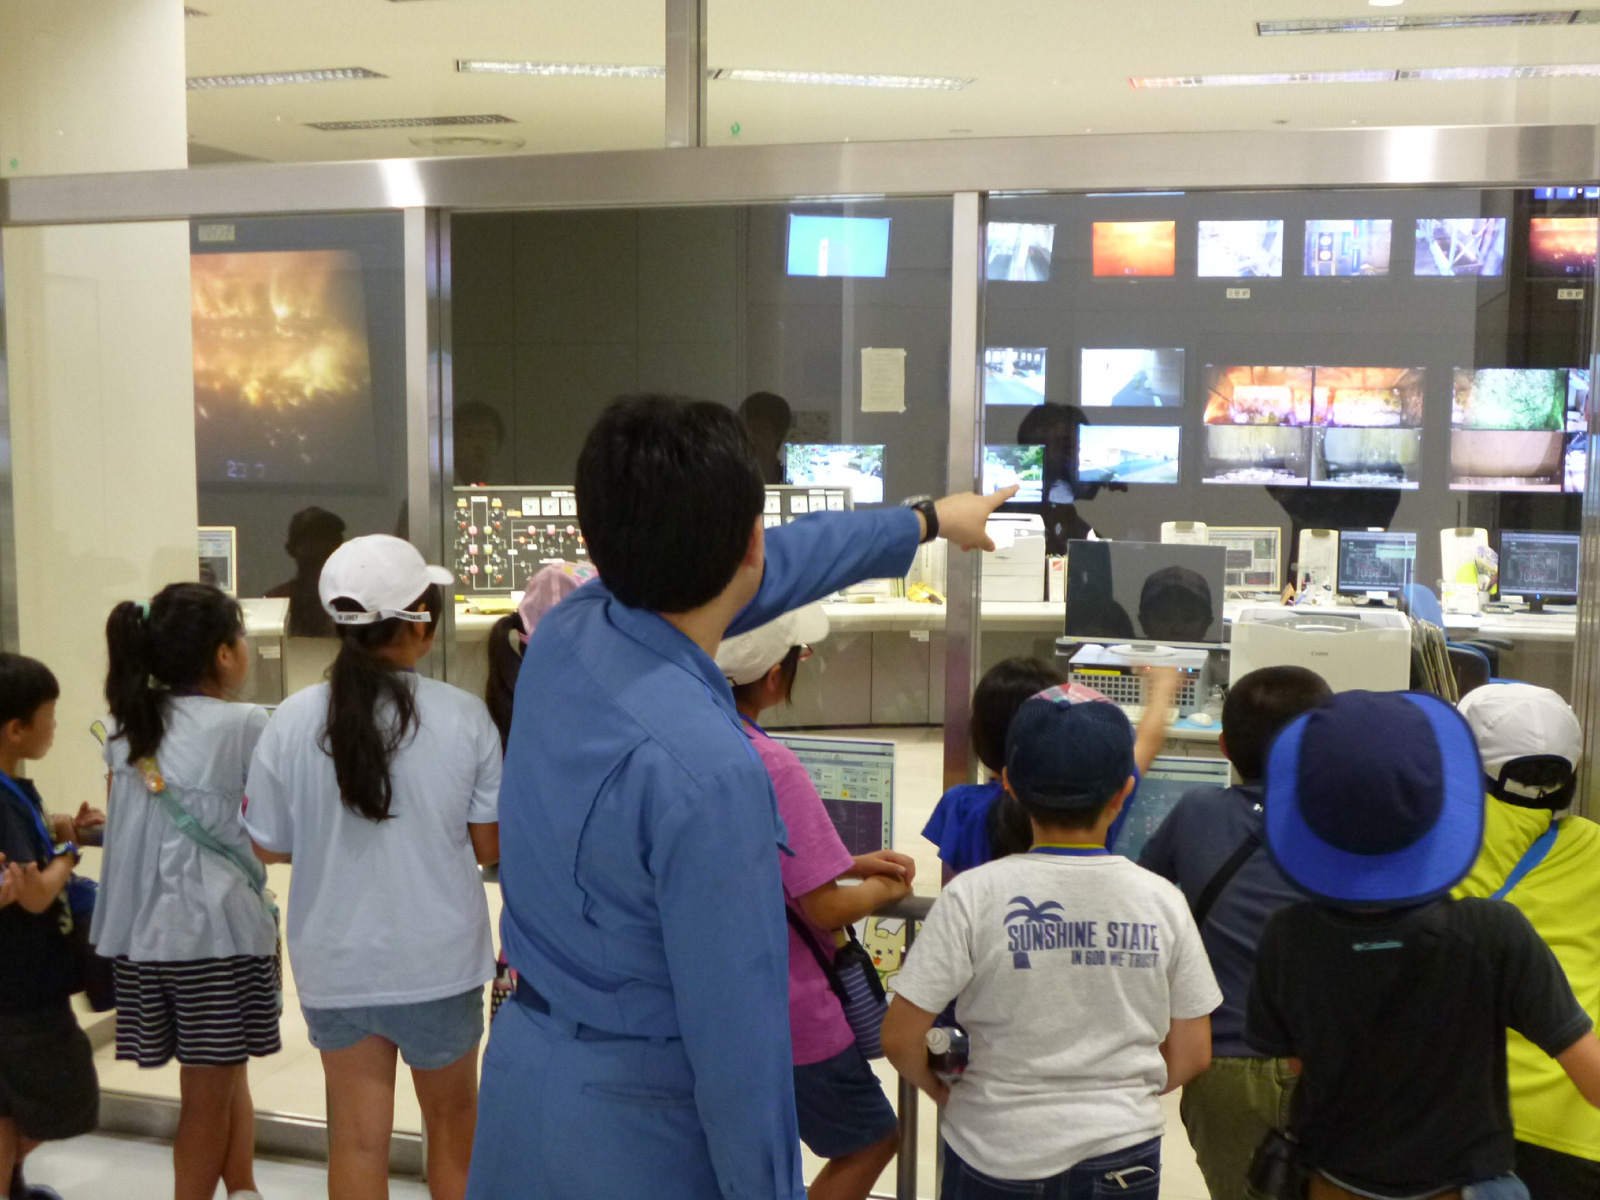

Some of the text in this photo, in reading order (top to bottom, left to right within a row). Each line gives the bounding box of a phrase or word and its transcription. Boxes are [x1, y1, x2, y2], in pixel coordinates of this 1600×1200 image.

[1007, 921, 1160, 951] SUNSHINE STATE
[1071, 950, 1082, 965] IN
[1085, 950, 1106, 966] GOD
[1110, 951, 1124, 967] WE
